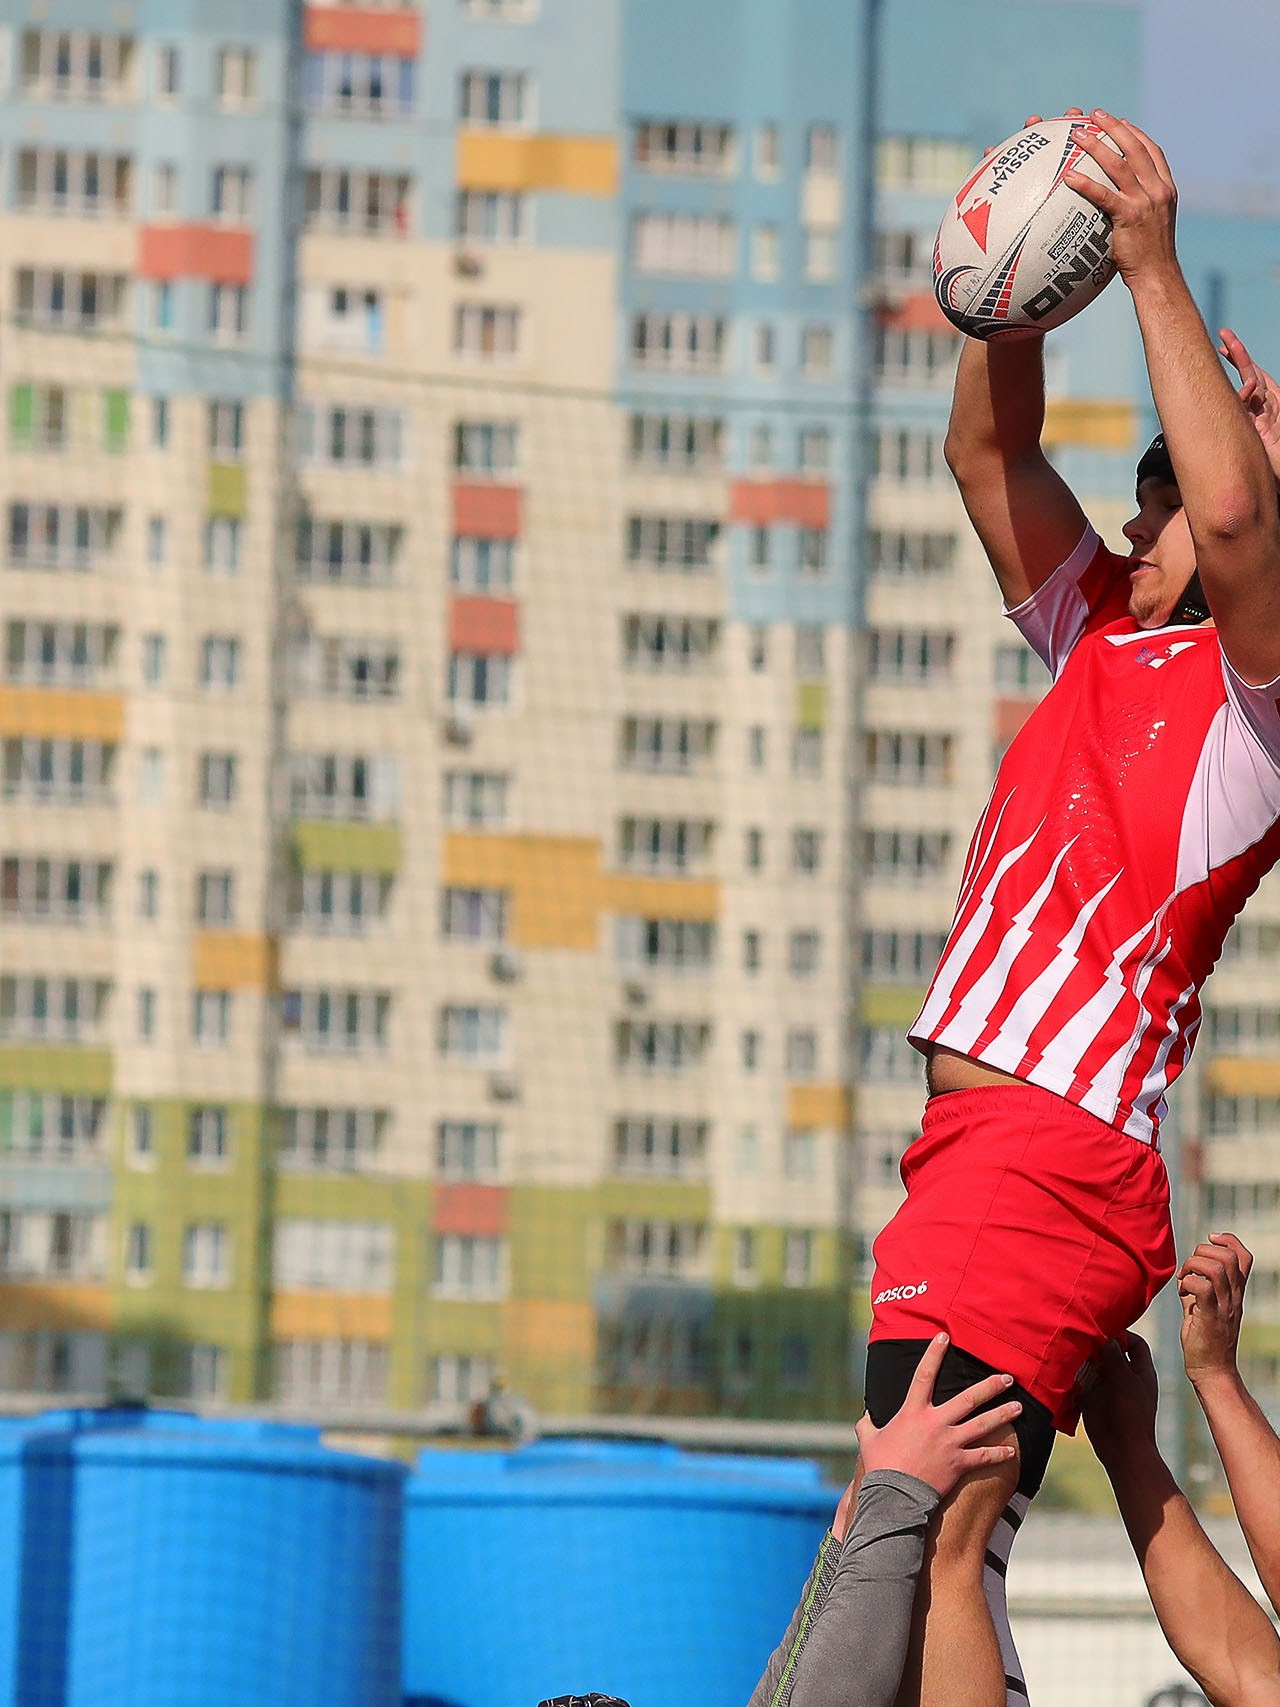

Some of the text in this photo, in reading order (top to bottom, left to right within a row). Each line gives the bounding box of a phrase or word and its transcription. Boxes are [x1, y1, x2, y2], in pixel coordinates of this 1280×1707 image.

[988, 136, 1051, 195] RUSSIAN
[992, 131, 1039, 176] RUGBY
[1050, 215, 1086, 258] AEROSENSA
[1021, 212, 1113, 321] HINO
[1042, 252, 1071, 282] ELITE
